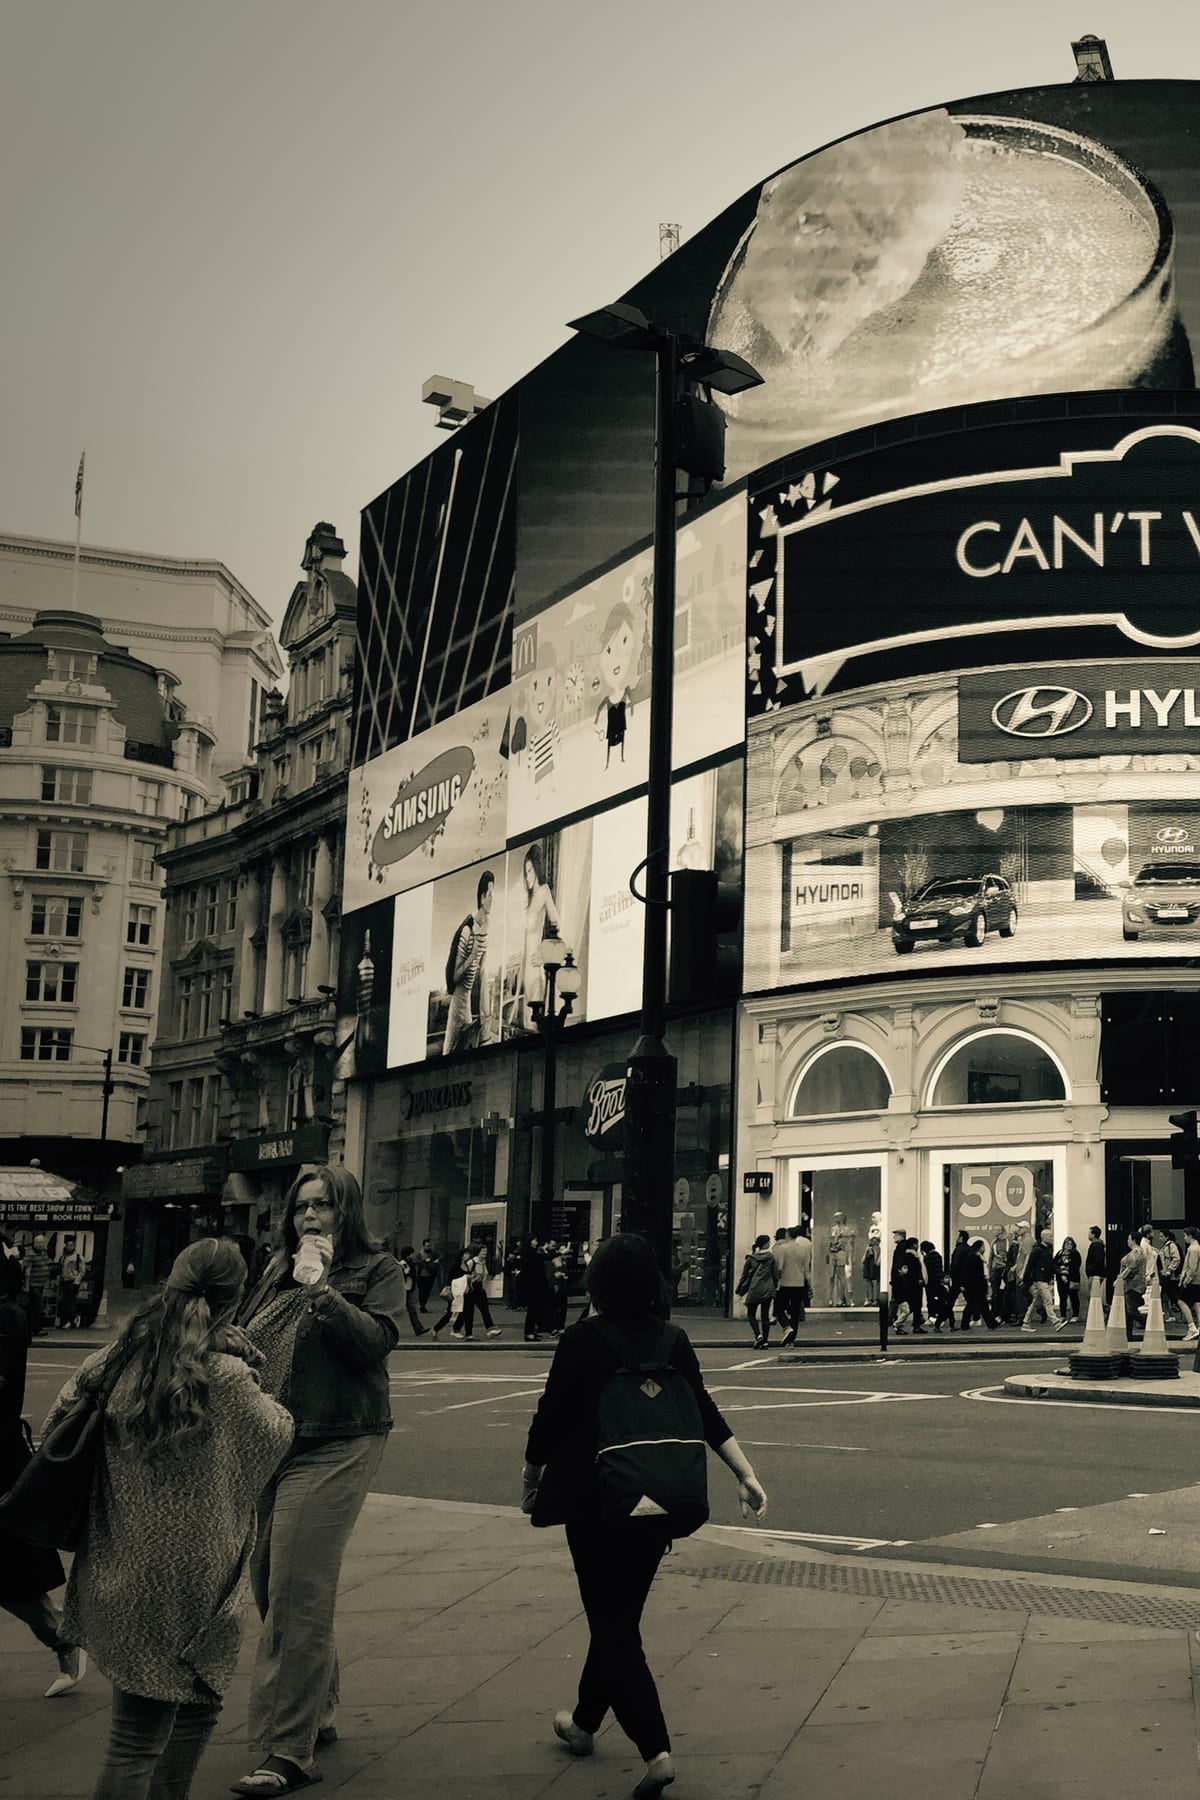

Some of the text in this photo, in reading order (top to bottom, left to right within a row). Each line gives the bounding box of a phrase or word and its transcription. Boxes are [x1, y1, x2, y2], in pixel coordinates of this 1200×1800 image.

[956, 511, 1162, 578] CAN'T
[383, 774, 461, 839] SAMSUNG
[1151, 845, 1195, 854] HYUNDAI
[796, 882, 864, 906] HYUNDAI
[584, 1078, 628, 1137] Boot
[29, 1204, 45, 1212] BEST
[958, 1166, 1034, 1218] 50
